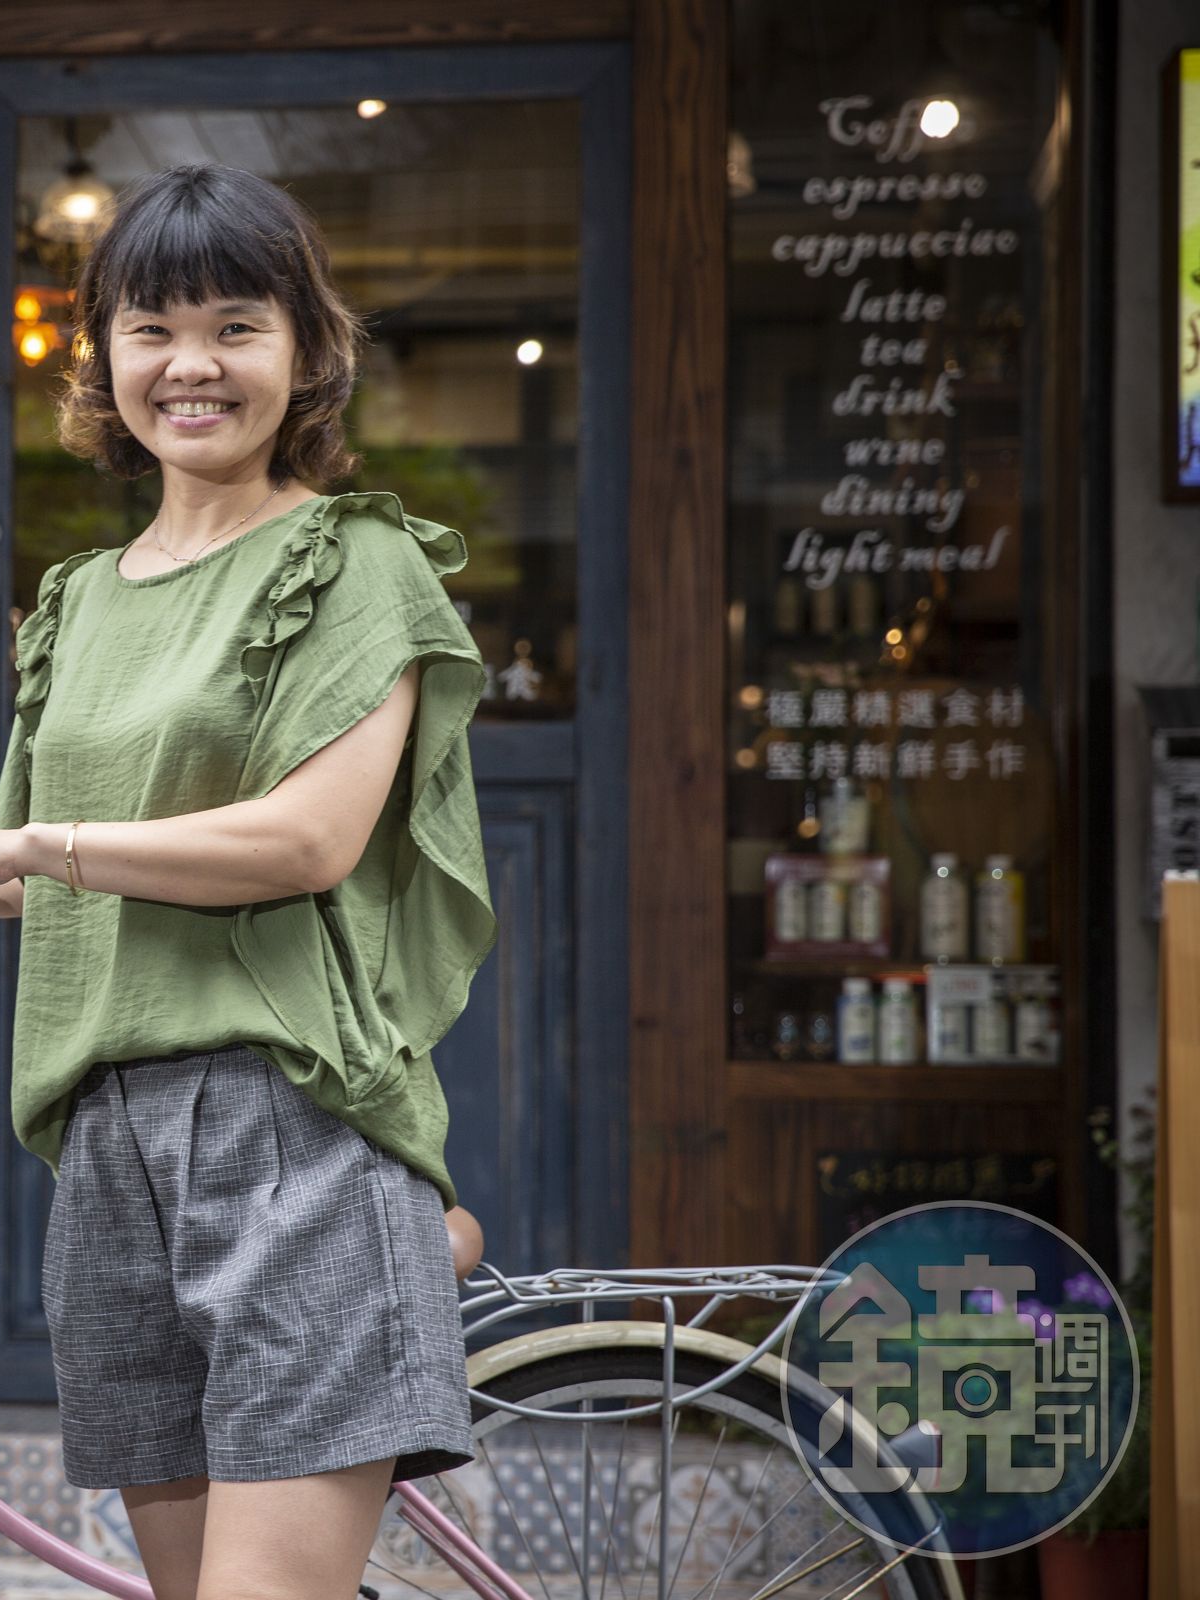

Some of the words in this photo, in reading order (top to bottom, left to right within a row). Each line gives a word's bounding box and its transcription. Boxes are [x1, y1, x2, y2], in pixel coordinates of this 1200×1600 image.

[802, 170, 988, 220] espresso
[840, 278, 947, 323] latte
[861, 332, 928, 367] tea
[832, 370, 964, 417] drink
[842, 434, 945, 467] wine
[821, 475, 966, 533] dining
[783, 527, 893, 590] light
[898, 525, 1011, 573] meal
[765, 739, 1027, 781] 堅持新鮮手作
